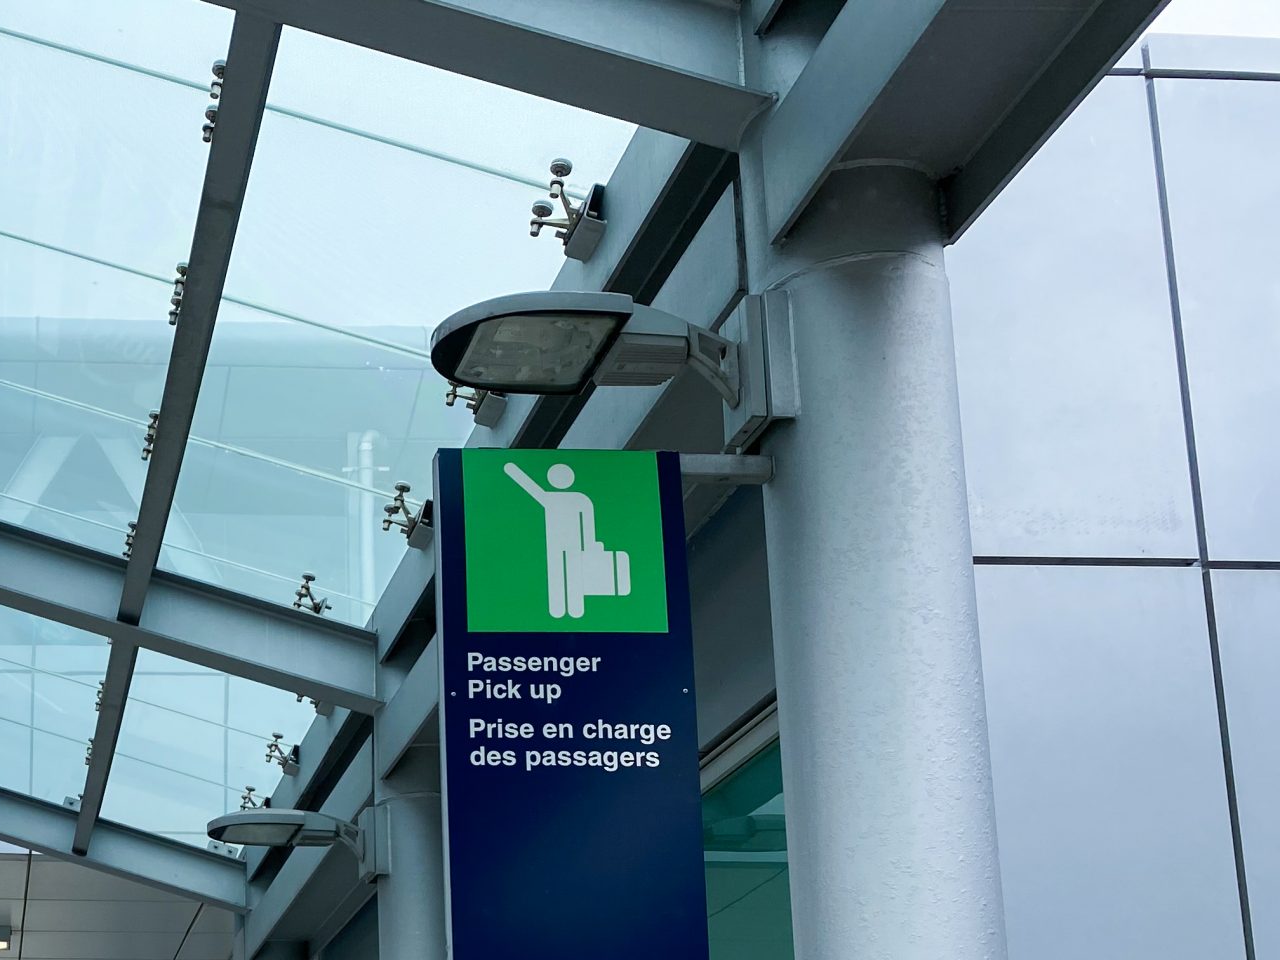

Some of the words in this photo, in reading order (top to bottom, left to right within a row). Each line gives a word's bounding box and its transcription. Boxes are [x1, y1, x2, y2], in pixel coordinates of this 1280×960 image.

[467, 652, 601, 677] Passenger
[468, 679, 522, 699] Pick
[530, 683, 562, 704] up
[470, 718, 535, 739] Prise
[542, 722, 574, 739] en
[582, 719, 672, 745] charge
[470, 746, 517, 766] des
[525, 750, 660, 772] passagers
